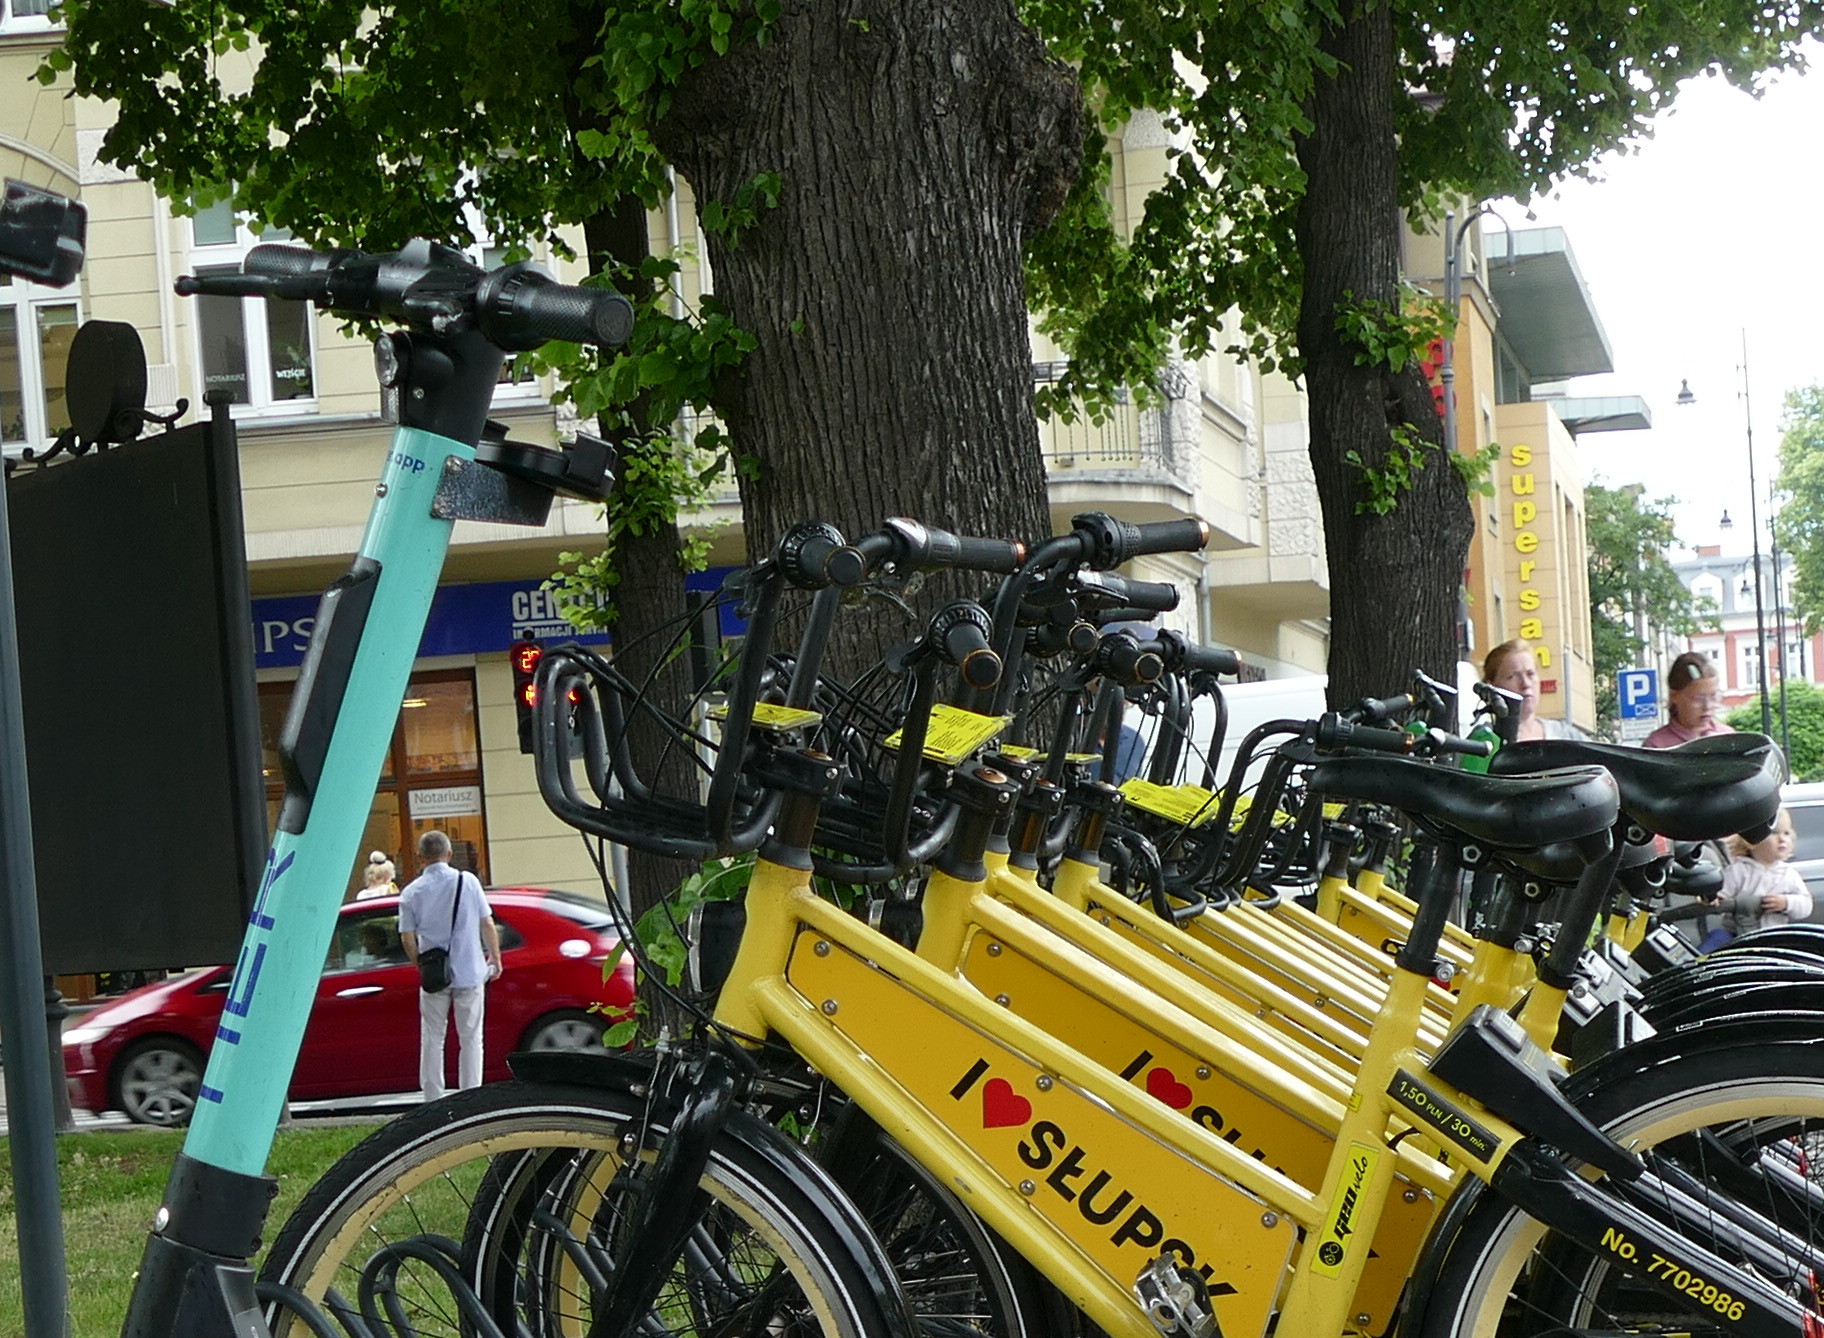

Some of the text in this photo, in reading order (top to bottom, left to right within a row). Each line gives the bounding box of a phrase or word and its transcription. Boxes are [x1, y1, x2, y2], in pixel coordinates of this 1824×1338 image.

[1626, 673, 1650, 706] P
[414, 789, 472, 804] Notariusz
[949, 1057, 991, 1102] I
[1398, 1080, 1427, 1107] 1,50
[1426, 1103, 1443, 1120] PLN
[1451, 1118, 1471, 1138] 30
[1469, 1135, 1487, 1152] min.
[1600, 1227, 1746, 1321] No. 7702986
